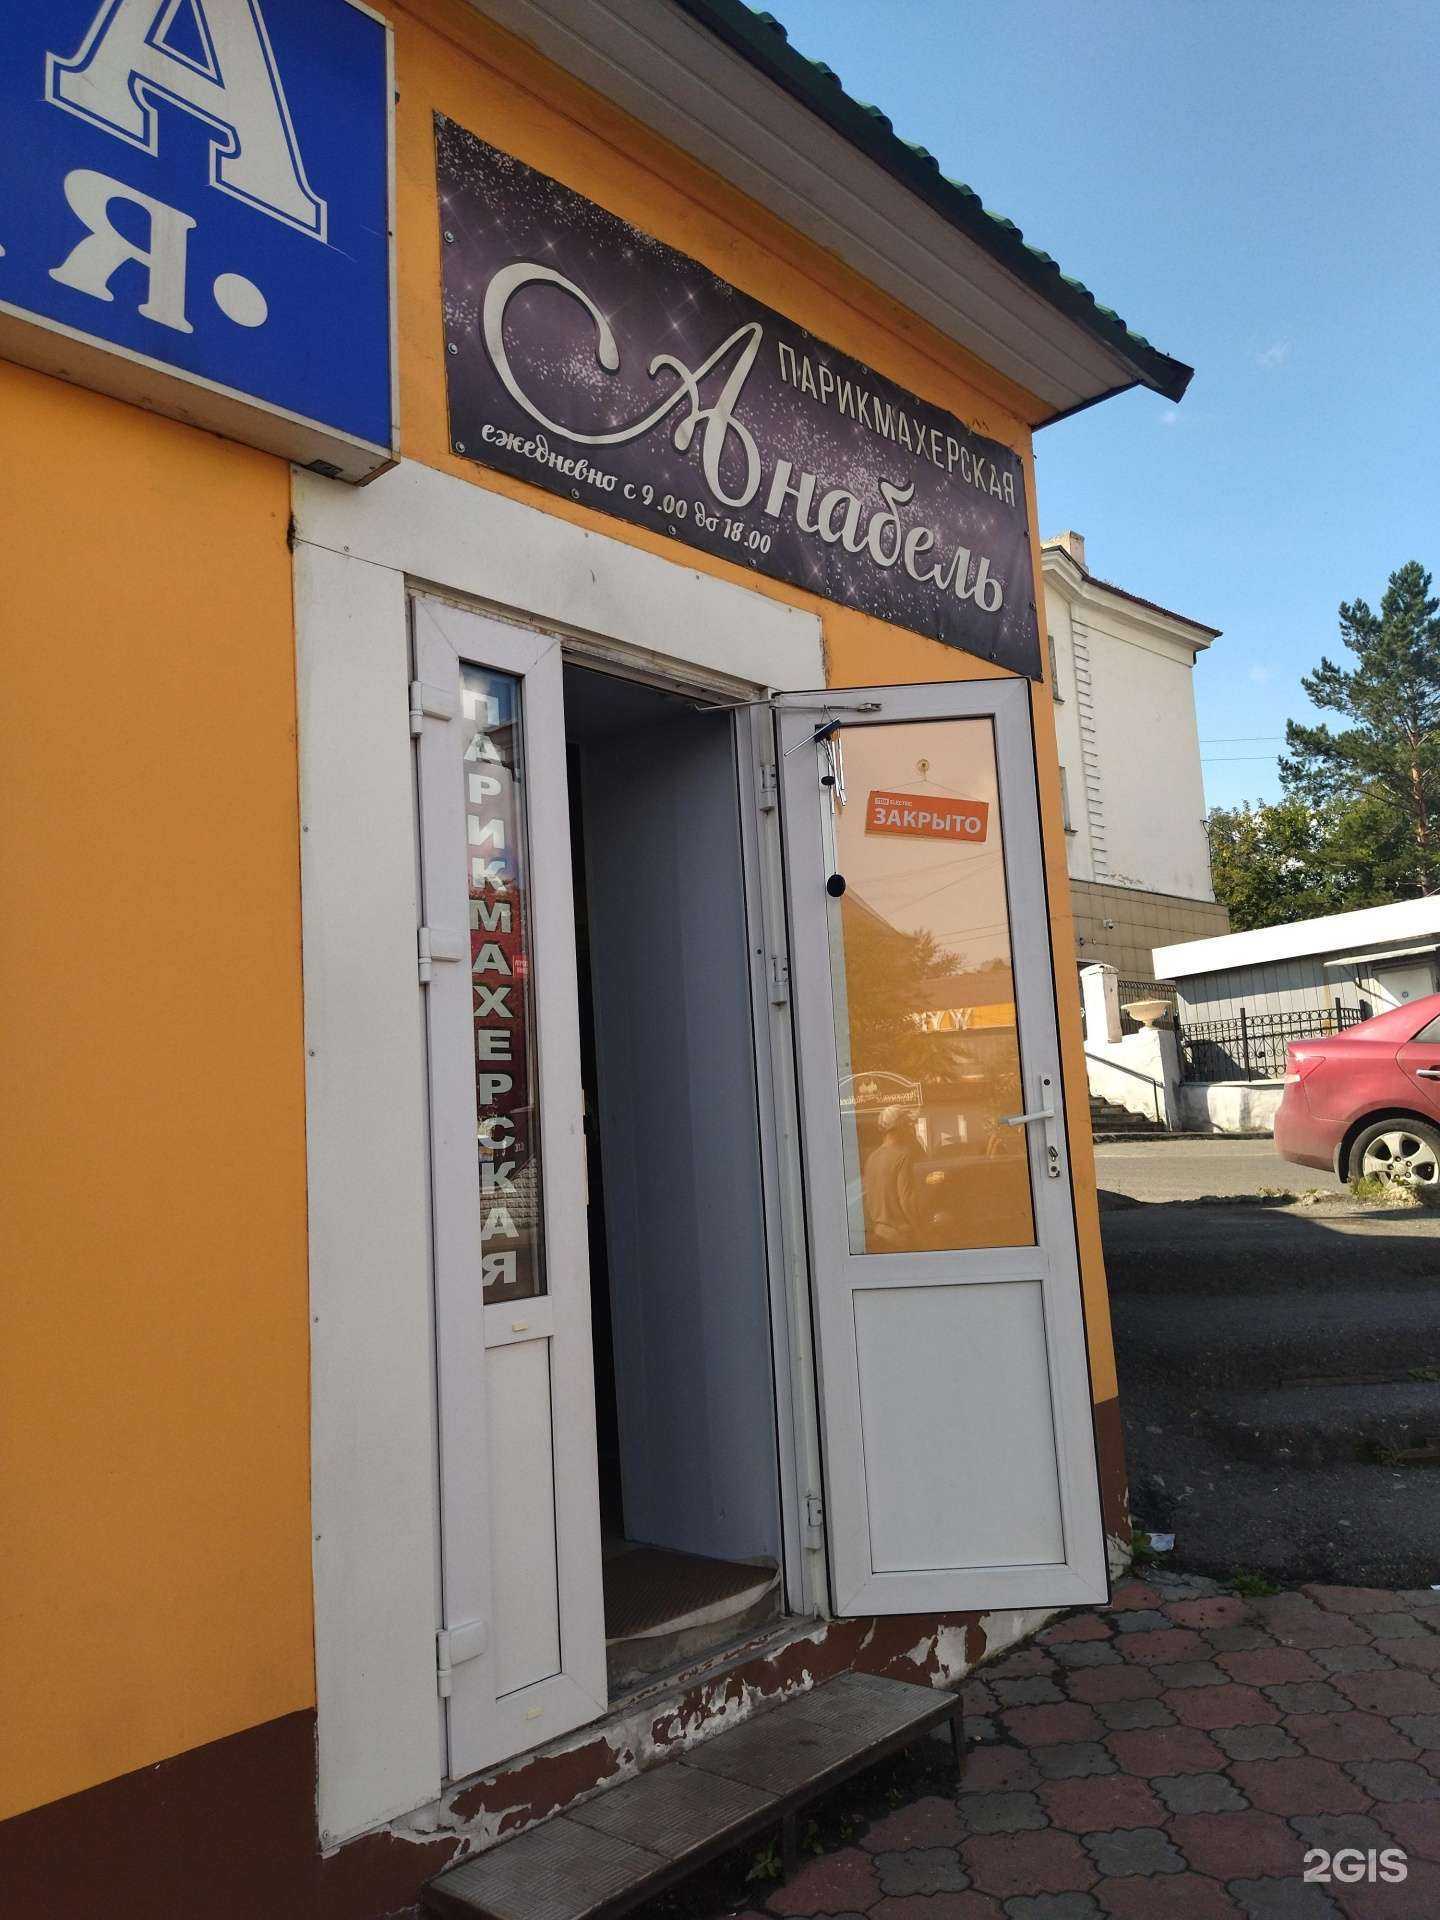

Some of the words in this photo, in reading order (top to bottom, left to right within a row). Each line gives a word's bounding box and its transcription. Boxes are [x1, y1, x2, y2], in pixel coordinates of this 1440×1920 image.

[481, 424, 618, 491] ежедневно
[623, 483, 637, 500] с
[641, 484, 688, 519] 9.00
[694, 501, 720, 532] до
[723, 518, 771, 554] 18.00
[484, 262, 1003, 613] Анабель
[778, 341, 1016, 508] ПАРИКМАХЕРСКАЯ
[873, 807, 981, 834] ЗАКРЫТО
[462, 688, 519, 1287] ПАРИКМАХЕРСКАЯ
